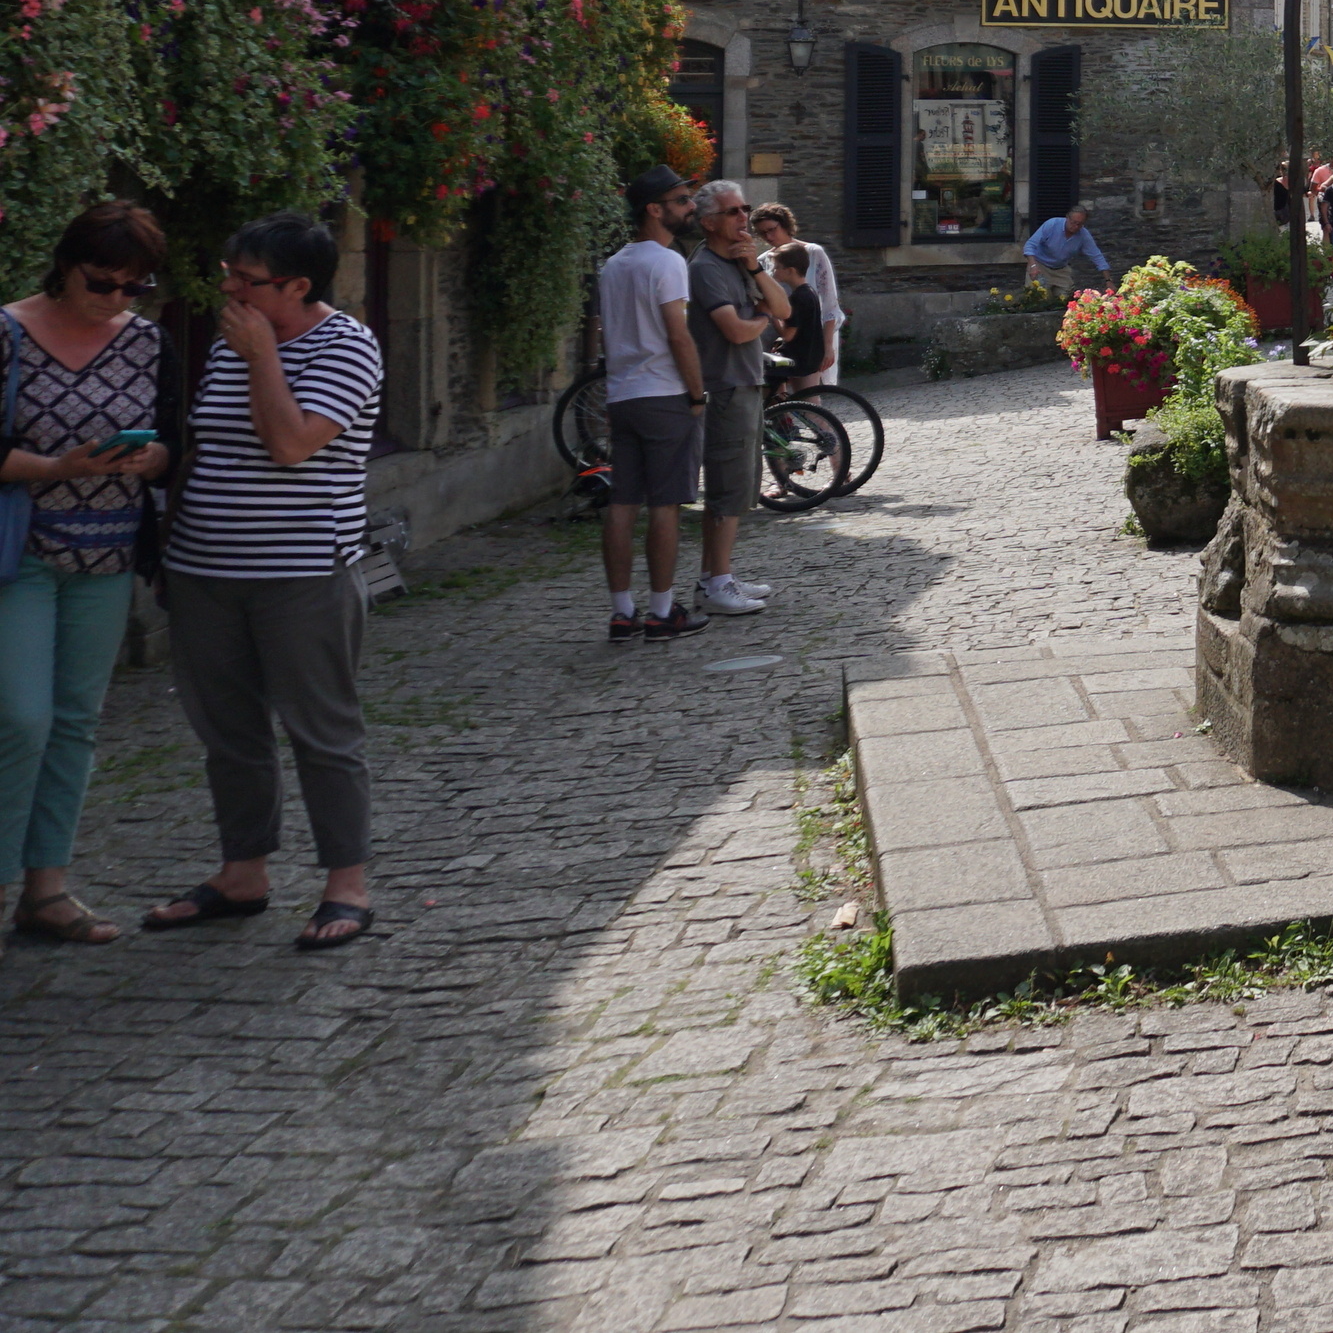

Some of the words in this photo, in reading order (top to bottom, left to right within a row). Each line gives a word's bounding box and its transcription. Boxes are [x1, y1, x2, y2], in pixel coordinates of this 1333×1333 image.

[922, 55, 963, 67] FLEURS
[967, 55, 982, 67] de
[986, 56, 1004, 67] LYS
